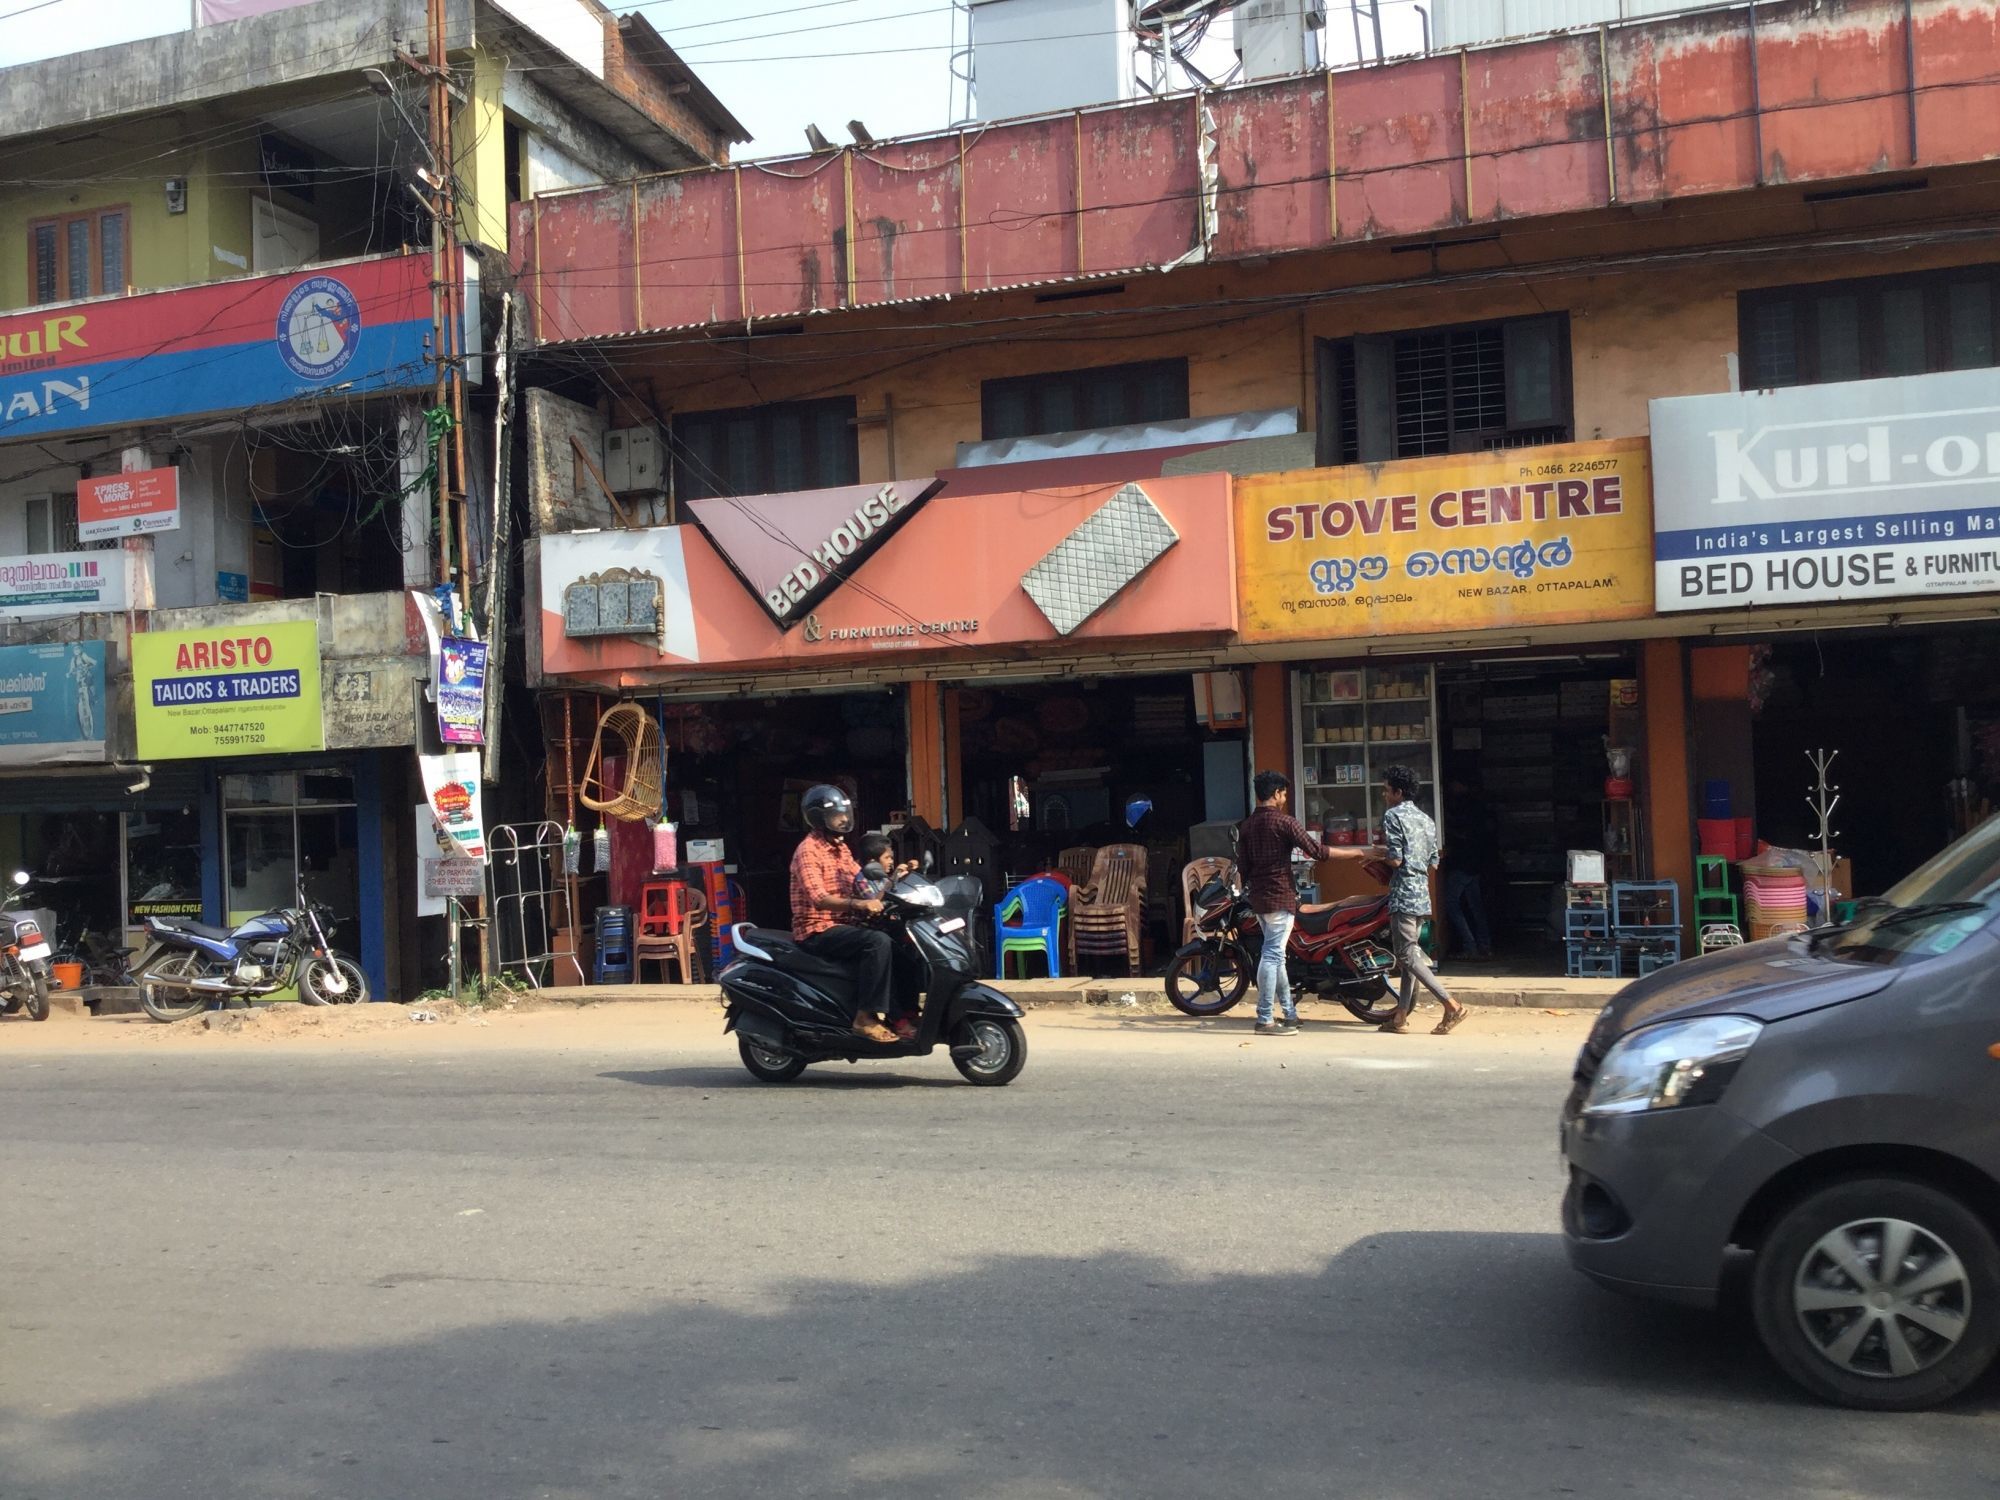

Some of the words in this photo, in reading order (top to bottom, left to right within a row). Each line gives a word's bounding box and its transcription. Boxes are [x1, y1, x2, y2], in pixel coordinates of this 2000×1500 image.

[0, 315, 89, 359] uR
[0, 376, 89, 420] AN
[1569, 459, 1618, 472] 2246577
[1267, 494, 1418, 542] STOVE
[1429, 475, 1623, 528] CENTRE
[764, 563, 820, 617] BED
[812, 482, 907, 574] HOUSE
[1696, 530, 1769, 551] India's
[1780, 524, 1864, 546] Largest
[1875, 517, 1954, 538] Selling
[1458, 588, 1482, 598] NEW
[1536, 578, 1613, 593] OTTAPALAM
[1680, 561, 1754, 598] BED
[1766, 552, 1896, 592] HOUSE
[1905, 556, 1918, 577] &
[803, 613, 825, 642] &
[830, 624, 916, 640] FURNITURE
[918, 619, 979, 635] CENTRE
[175, 636, 273, 672] ARISTO
[155, 681, 213, 702] TAILORS
[217, 680, 228, 698] &
[232, 675, 298, 697] TRADERS
[213, 722, 265, 734] 9447747520
[214, 734, 265, 745] 7559917520
[134, 905, 151, 914] NEW
[151, 904, 181, 914] FASHION
[181, 903, 202, 913] CYCLE
